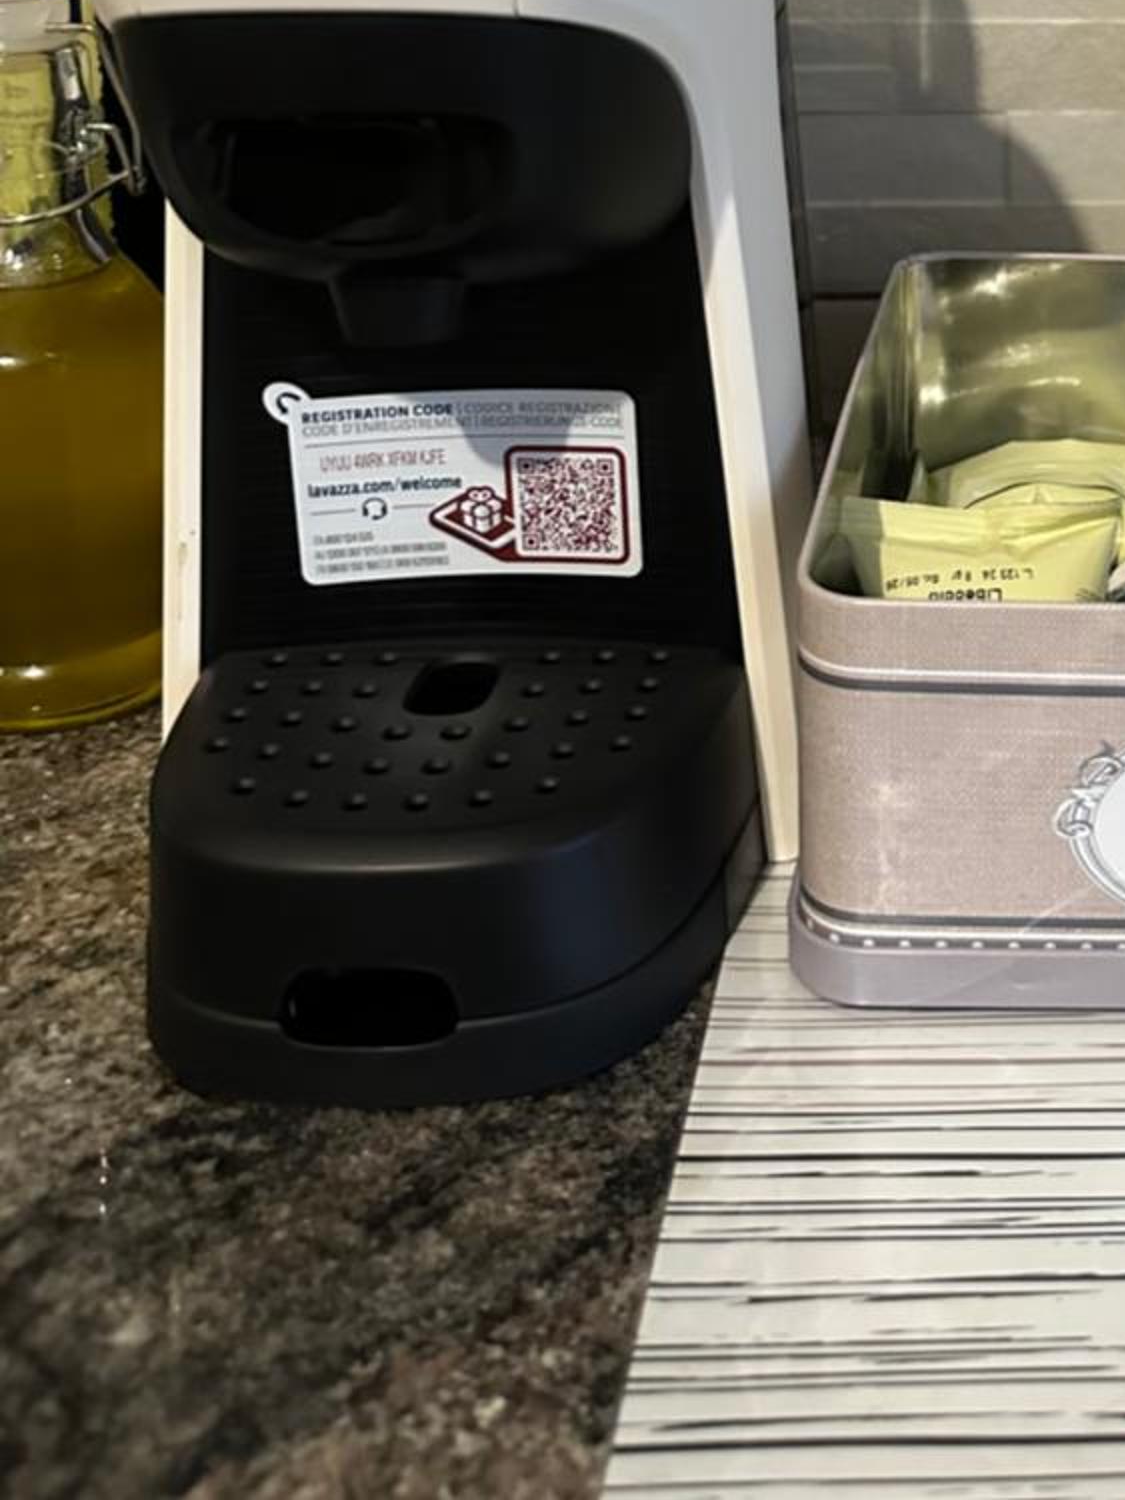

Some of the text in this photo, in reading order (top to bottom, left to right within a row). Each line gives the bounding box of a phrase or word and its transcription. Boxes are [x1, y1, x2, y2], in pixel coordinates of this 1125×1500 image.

[301, 405, 409, 424] REGISTRATION
[412, 402, 453, 417] CODE
[301, 424, 339, 438] CODE
[307, 475, 462, 499] lavazza.com/welcome
